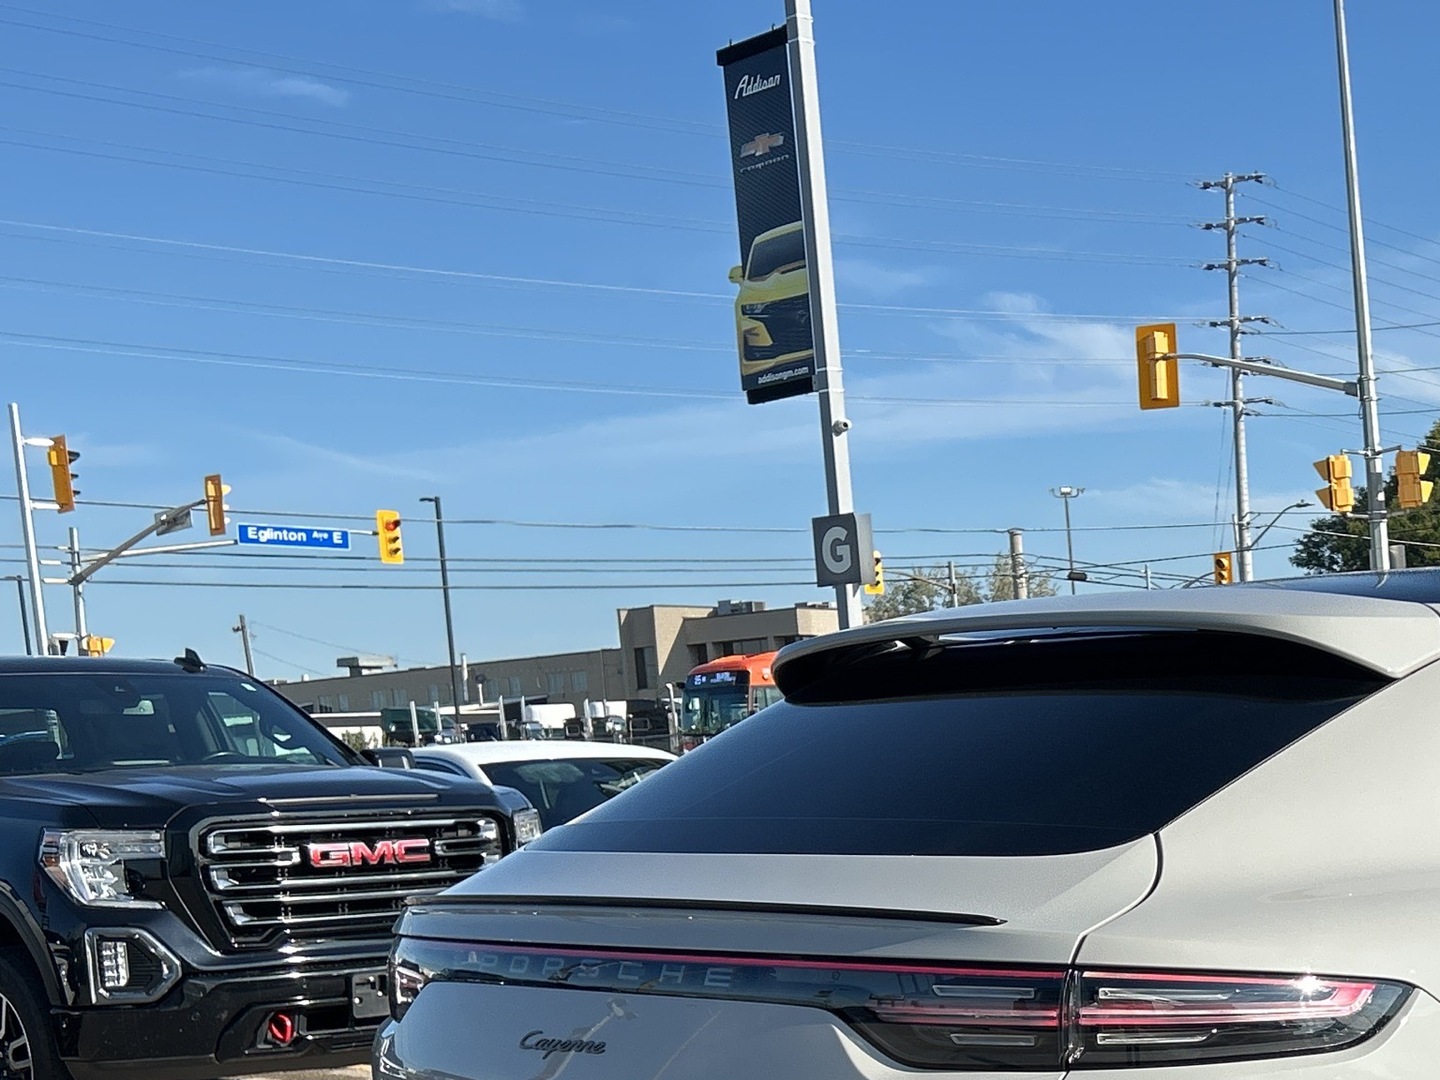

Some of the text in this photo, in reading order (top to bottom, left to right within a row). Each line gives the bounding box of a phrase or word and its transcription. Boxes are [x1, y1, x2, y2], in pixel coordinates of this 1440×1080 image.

[734, 74, 781, 99] Addison
[247, 526, 307, 542] Eglinton
[332, 531, 344, 544] E
[822, 526, 852, 574] G
[308, 838, 431, 868] GMC
[477, 954, 734, 988] PORSCHE
[518, 1030, 607, 1060] Cayenne
